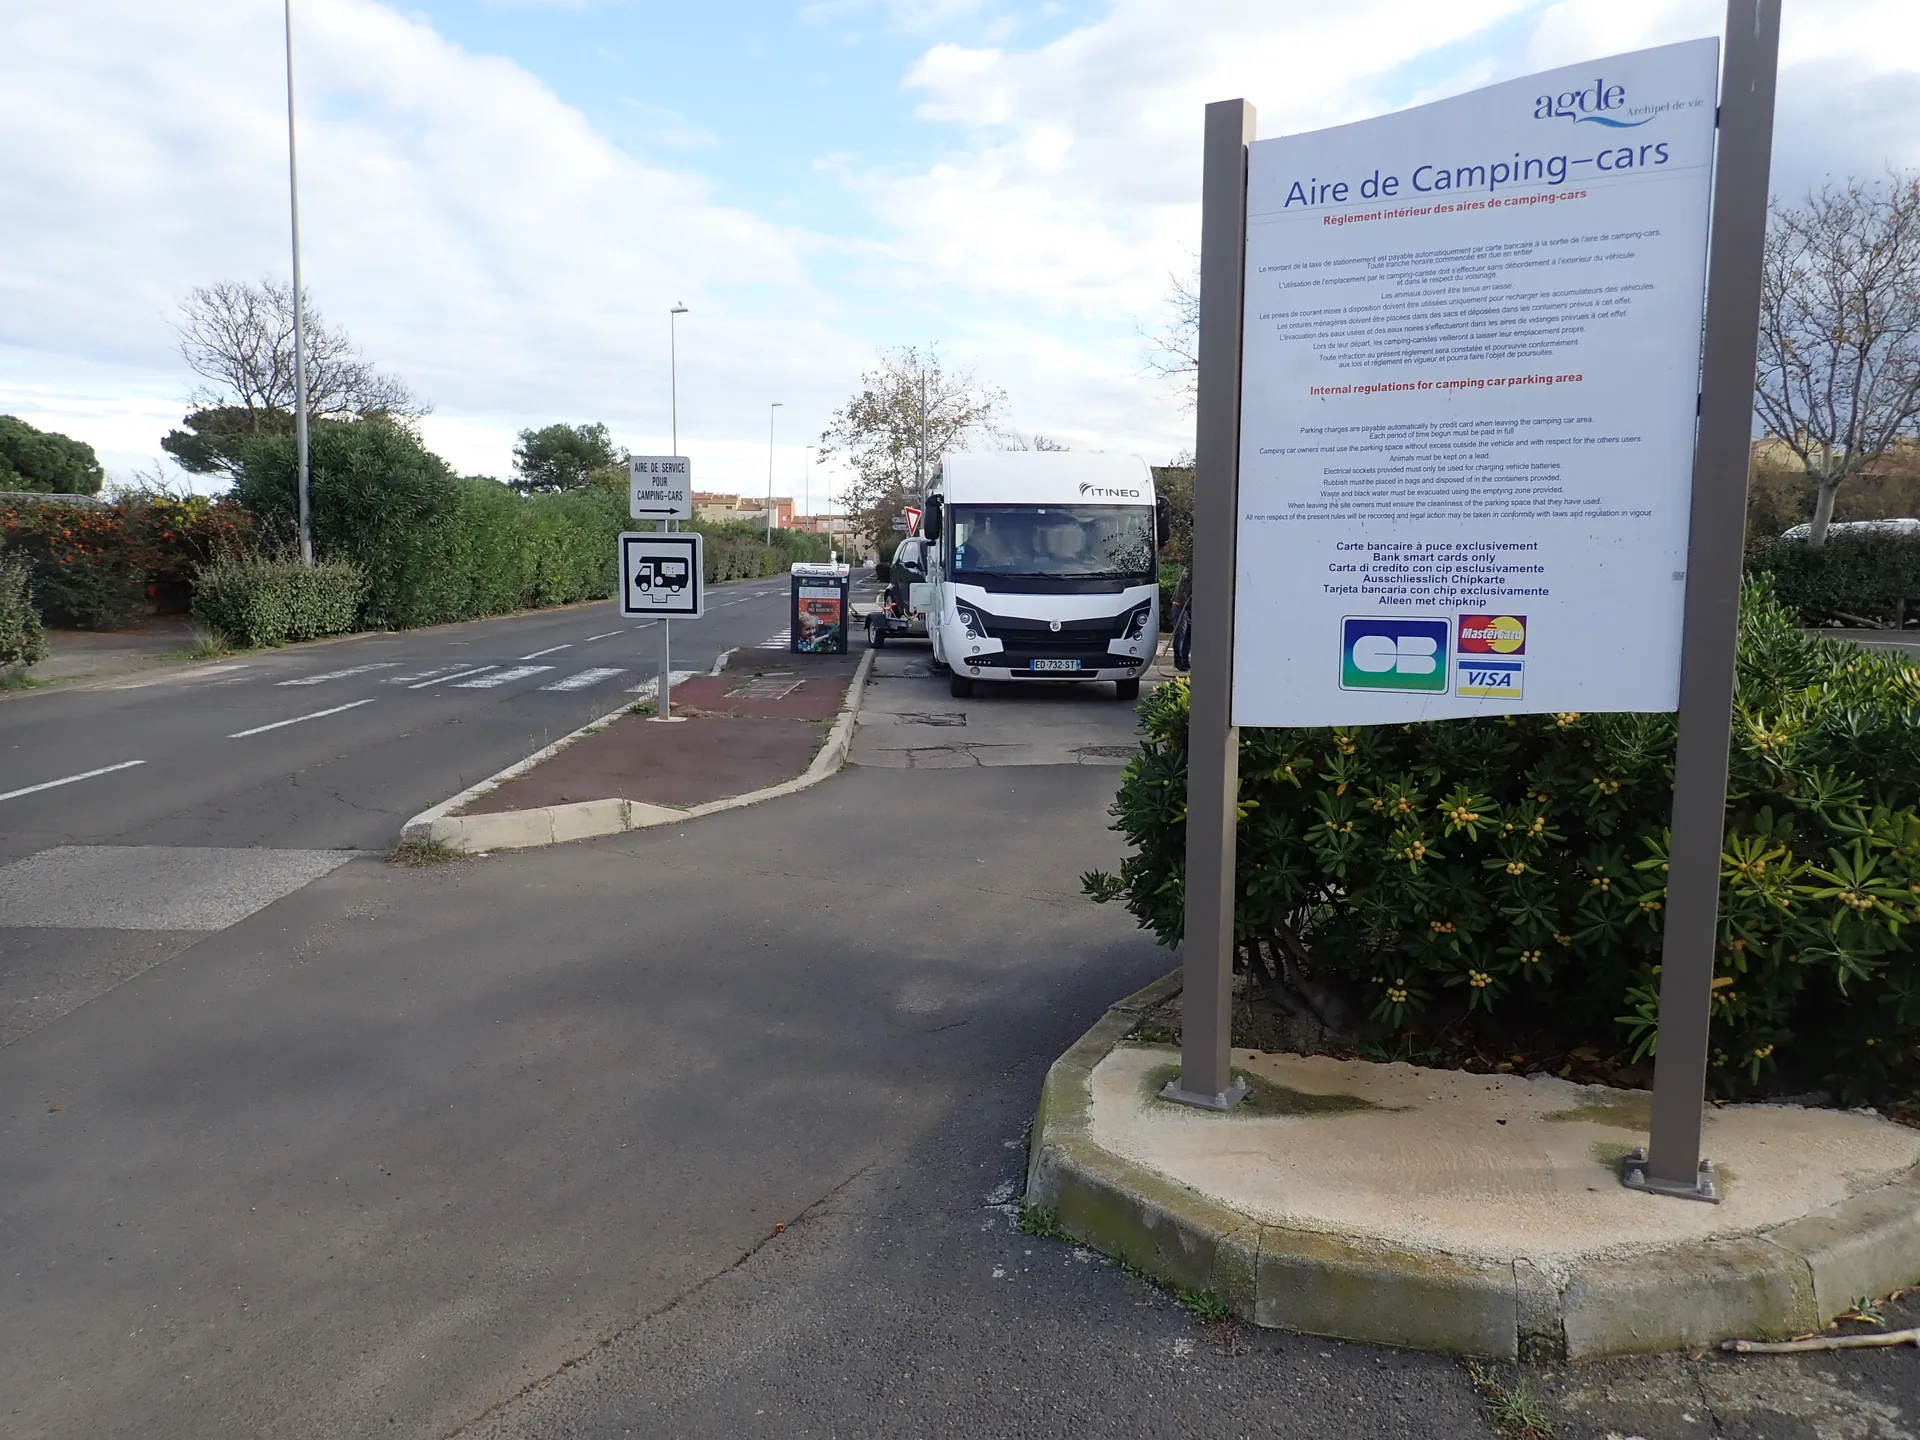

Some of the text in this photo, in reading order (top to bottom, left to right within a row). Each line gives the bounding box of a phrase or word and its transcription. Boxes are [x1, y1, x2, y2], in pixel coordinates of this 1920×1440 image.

[1533, 78, 1625, 123] agde
[1626, 97, 1704, 116] Archipel de vie
[1284, 176, 1349, 208] Aire
[1360, 169, 1399, 199] de
[1384, 206, 1431, 219] intérieur
[1434, 203, 1454, 214] des
[1456, 200, 1485, 211] aires
[1487, 198, 1502, 208] de
[1504, 190, 1587, 206] camping-cars
[1422, 288, 1447, 296] doivent
[1348, 316, 1372, 324] doivent
[1532, 303, 1568, 311] containers
[1384, 336, 1438, 346] camping-caristes
[1439, 333, 1469, 342] veilleront
[1513, 327, 1560, 338] emplacement
[1310, 374, 1583, 395] Internal regulations for camping car parking area
[1300, 426, 1324, 434] Parking
[1324, 426, 1349, 434] charges
[1361, 424, 1386, 433] payable
[1387, 422, 1429, 430] automatically
[1429, 422, 1438, 430] by
[1494, 419, 1519, 427] leaving
[1532, 417, 1562, 426] camping
[1386, 432, 1407, 440] period
[1430, 430, 1452, 439] begun
[1480, 428, 1495, 437] paid
[1443, 453, 1458, 462] kept
[634, 462, 685, 473] AIRE DE SERVICE
[1377, 466, 1405, 475] provided
[1422, 465, 1436, 474] only
[1475, 464, 1504, 472] charging
[652, 476, 668, 486] POUR
[1375, 477, 1396, 486] placed
[1404, 477, 1421, 485] bags
[1435, 476, 1465, 485] disposed
[637, 490, 683, 501] CAMPING-CARS
[1091, 488, 1140, 497] ITINEO
[1336, 542, 1538, 552] Carte bancaire à puce exclusivement
[1373, 553, 1495, 563] Bank smart cards only
[1329, 563, 1356, 572] Carta
[1359, 563, 1369, 572] di
[1372, 564, 1410, 572] credito
[1436, 564, 1453, 574] cip
[1455, 564, 1544, 572] esclusivamente
[1363, 574, 1505, 585] Ausschliesslich Chipkarte
[1323, 585, 1358, 595] Tarjeta
[1361, 586, 1407, 594] bancaria
[1433, 586, 1457, 596] chip
[1460, 586, 1549, 595] exclusivamente
[1379, 596, 1487, 608] Alleen met chipknip
[1462, 628, 1523, 640] MasterCard
[1468, 672, 1511, 686] VISA
